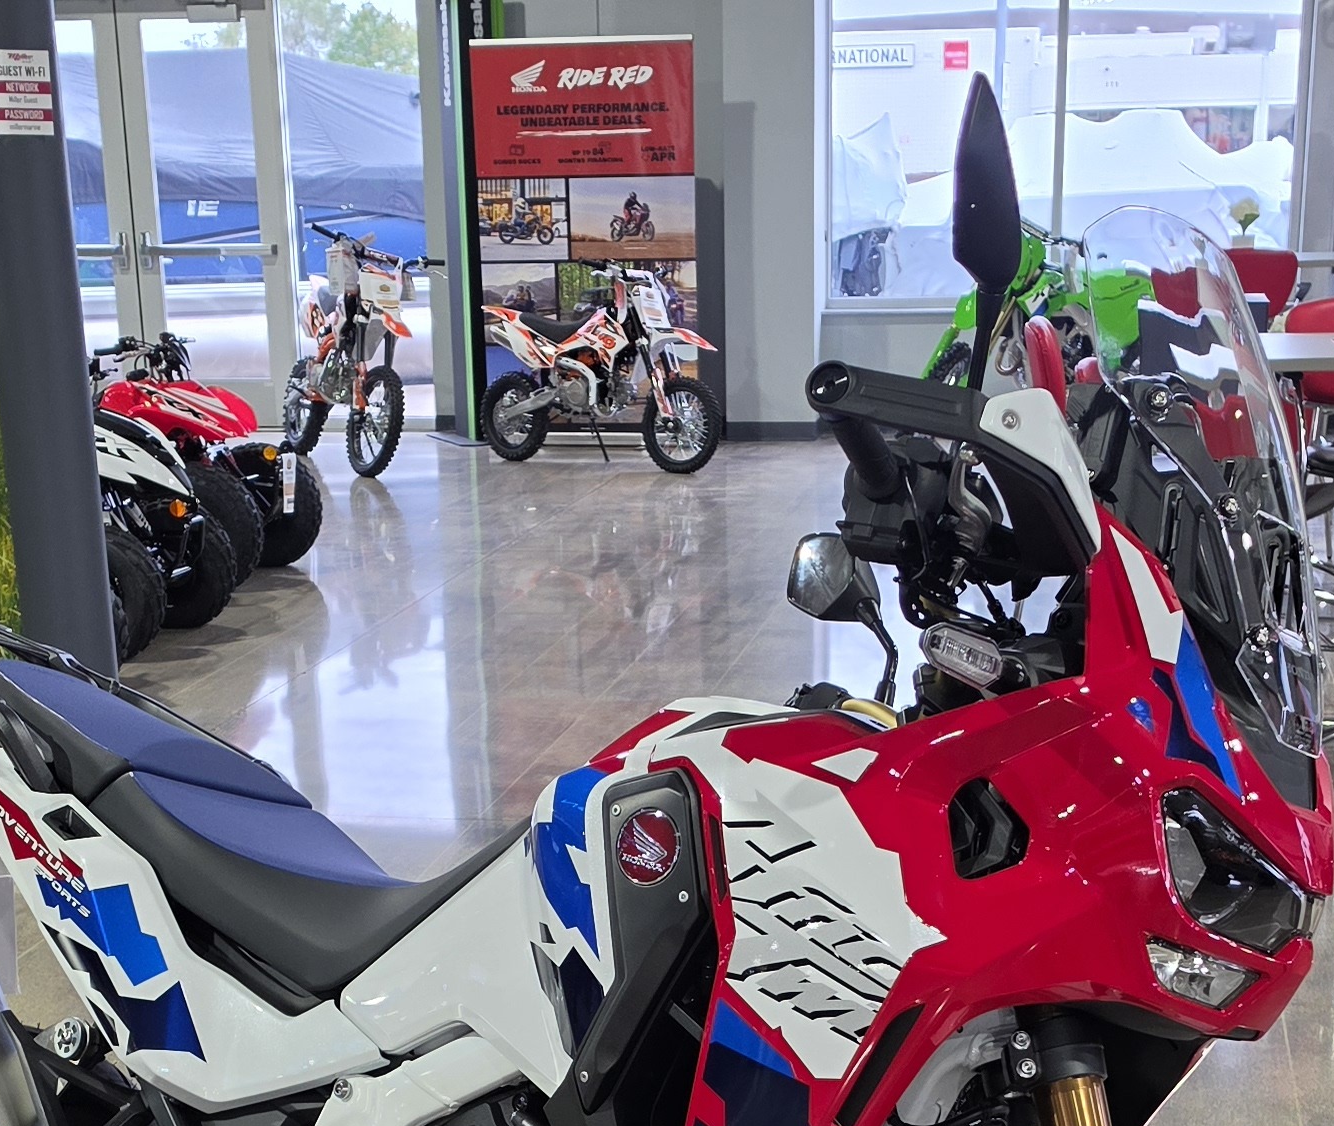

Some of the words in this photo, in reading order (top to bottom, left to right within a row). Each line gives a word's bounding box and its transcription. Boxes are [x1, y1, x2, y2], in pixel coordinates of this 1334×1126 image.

[25, 65, 46, 77] WI-FI
[556, 66, 608, 90] RIDE
[607, 65, 654, 90] RED
[5, 82, 40, 92] NETWORK
[511, 85, 548, 93] HONDA
[4, 109, 44, 119] PASSWORD
[496, 103, 568, 115] LEGENDARY
[572, 102, 669, 114] PERFORMANCE.
[520, 115, 600, 127] UNBEATABLE
[602, 114, 646, 126] DEALS.
[650, 152, 676, 163] APR
[33, 865, 91, 918] SPORTS
